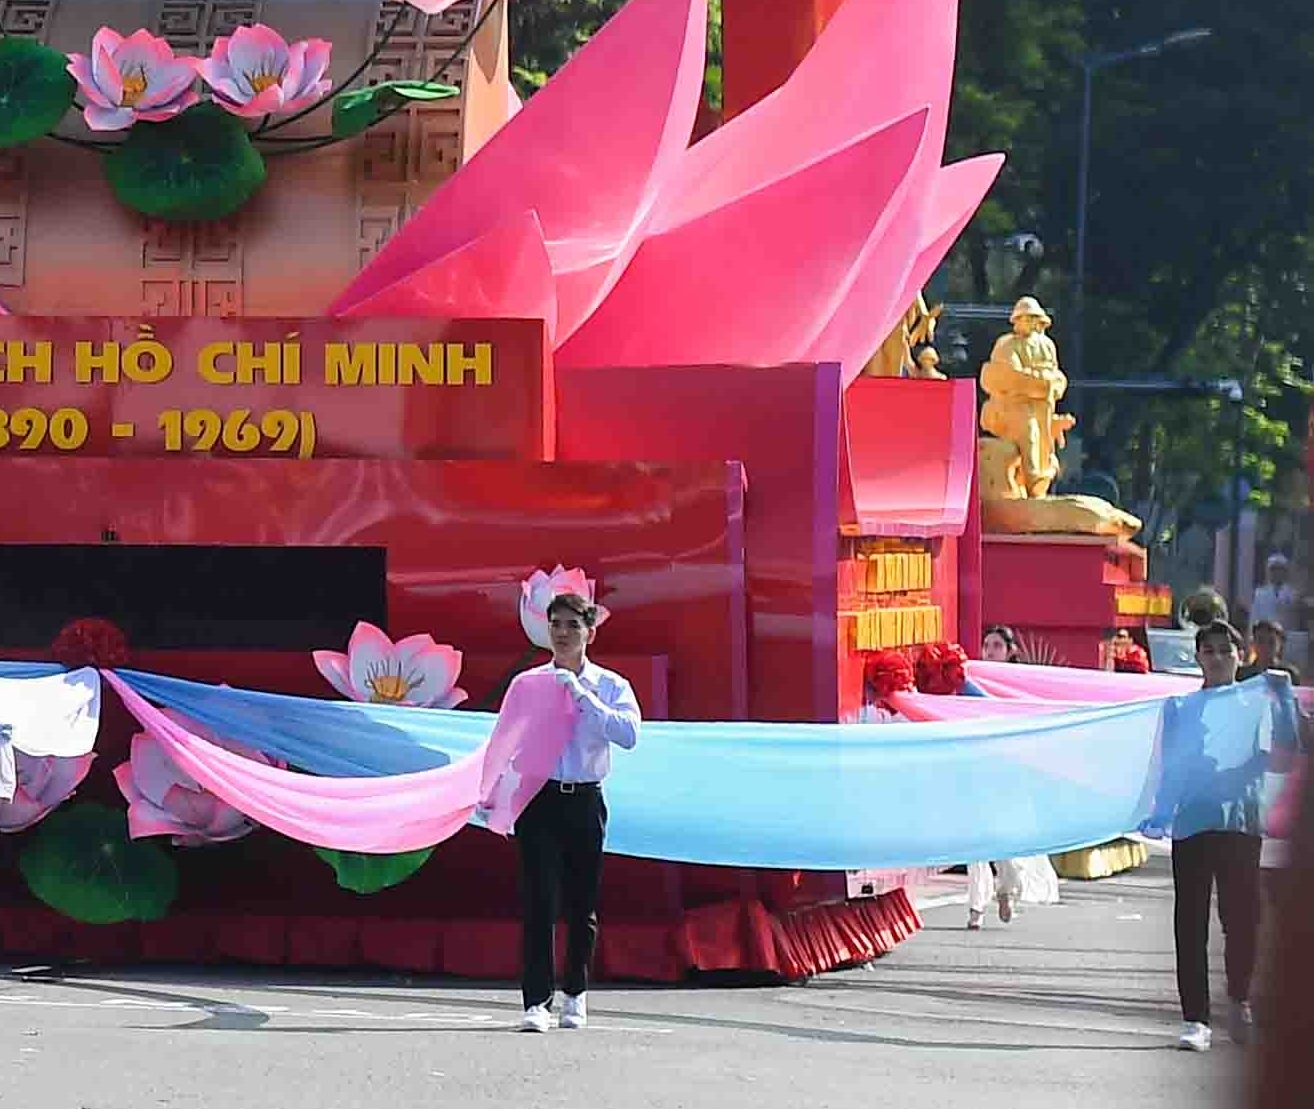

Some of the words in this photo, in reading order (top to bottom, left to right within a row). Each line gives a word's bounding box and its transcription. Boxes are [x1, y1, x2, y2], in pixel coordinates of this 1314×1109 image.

[75, 323, 174, 384] HỒ
[198, 330, 302, 385] CHÍ
[324, 342, 493, 386] MINH
[112, 423, 135, 438] -
[158, 408, 316, 459] 1969)
